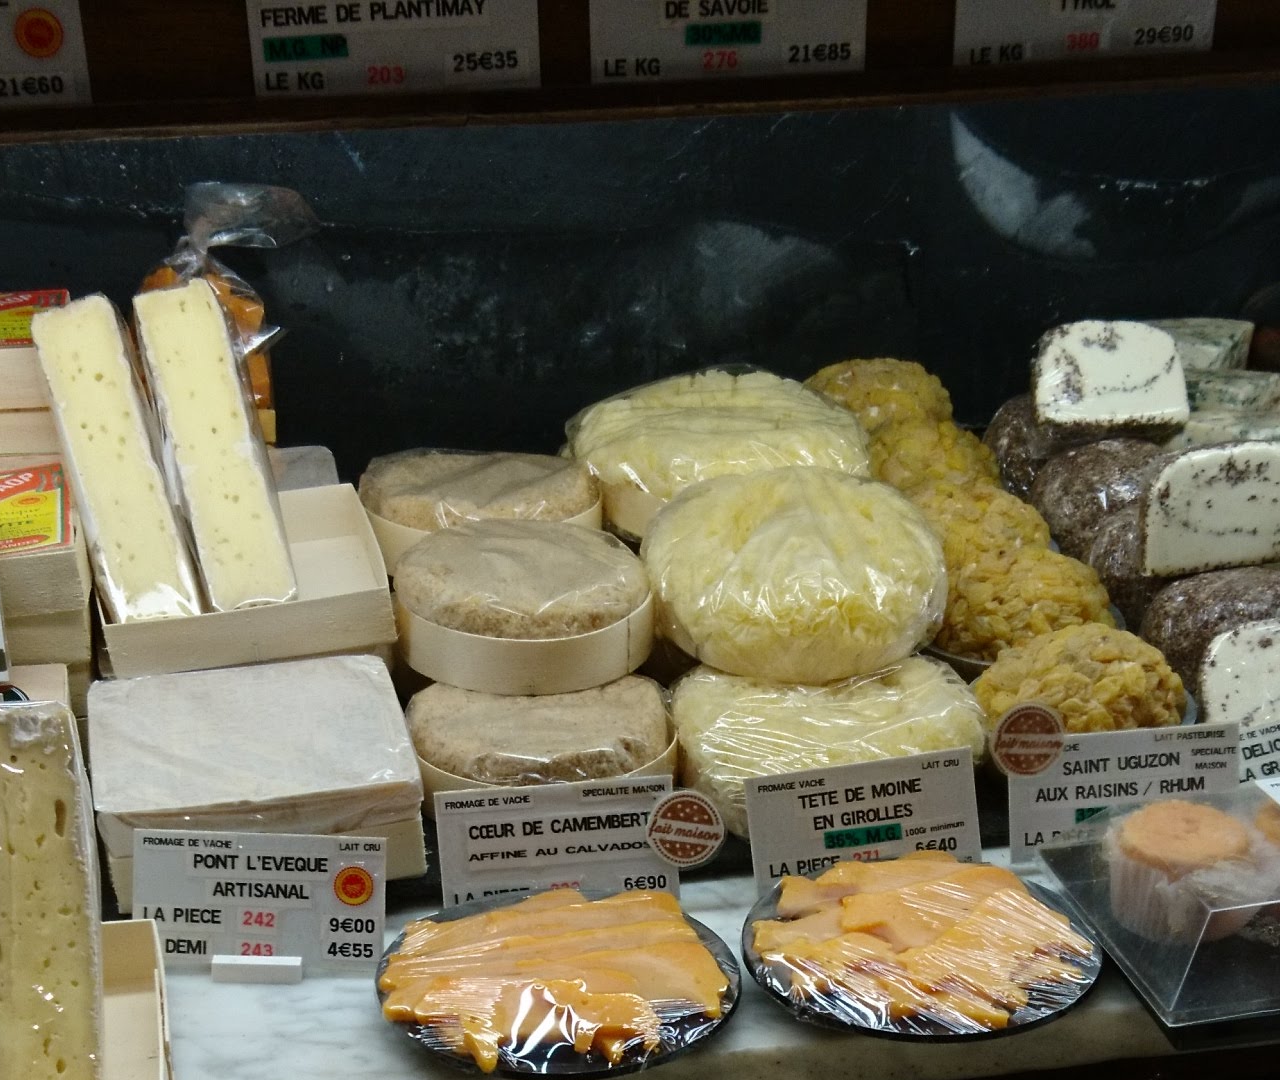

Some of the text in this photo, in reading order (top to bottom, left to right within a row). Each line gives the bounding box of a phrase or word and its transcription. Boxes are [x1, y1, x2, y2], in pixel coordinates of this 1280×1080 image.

[261, 0, 485, 27] FERME DE PLANTIMAY
[665, 0, 768, 18] DE SAVOIE
[1133, 25, 1194, 46] 29€90
[453, 51, 518, 72] 25€35
[789, 43, 851, 63] 21€85
[970, 45, 1023, 64] LE KG
[367, 67, 405, 84] 203
[604, 59, 661, 77] LE KG
[265, 72, 325, 90] LE KG
[1154, 730, 1225, 742] LAIT PASTEURISE
[1191, 747, 1236, 757] SPECIALITE
[922, 758, 960, 770] LAIT CRU
[1063, 752, 1180, 776] SAINT UGUZON
[582, 783, 665, 797] SPECIALITE MAISON
[758, 778, 825, 793] FROMAGE VACHE
[797, 777, 922, 810] TETE DE MOINE
[1036, 776, 1205, 803] AUX RAISINS RHUM
[445, 795, 530, 810] FROMAGE DE VACHE
[522, 810, 649, 836] DE CAMEMBERT
[814, 803, 913, 831] EN GIROLLES
[673, 826, 722, 842] maison
[930, 821, 965, 833] minimum
[143, 837, 232, 849] FROMAGE DE VACHE
[339, 842, 381, 851] LAIT CRU
[1024, 832, 1044, 846] LA
[468, 846, 558, 862] AFFINE AU
[193, 854, 328, 873] PONT L'EVEQUE
[770, 861, 791, 878] LA
[624, 874, 667, 890] 6€90
[213, 882, 309, 900] ARTISANAL
[174, 908, 222, 925] PIECE
[242, 911, 275, 928] 242
[329, 917, 375, 934] 9€00
[165, 939, 207, 955] DEMI
[241, 942, 273, 956] 243
[327, 942, 373, 958] 4€55
